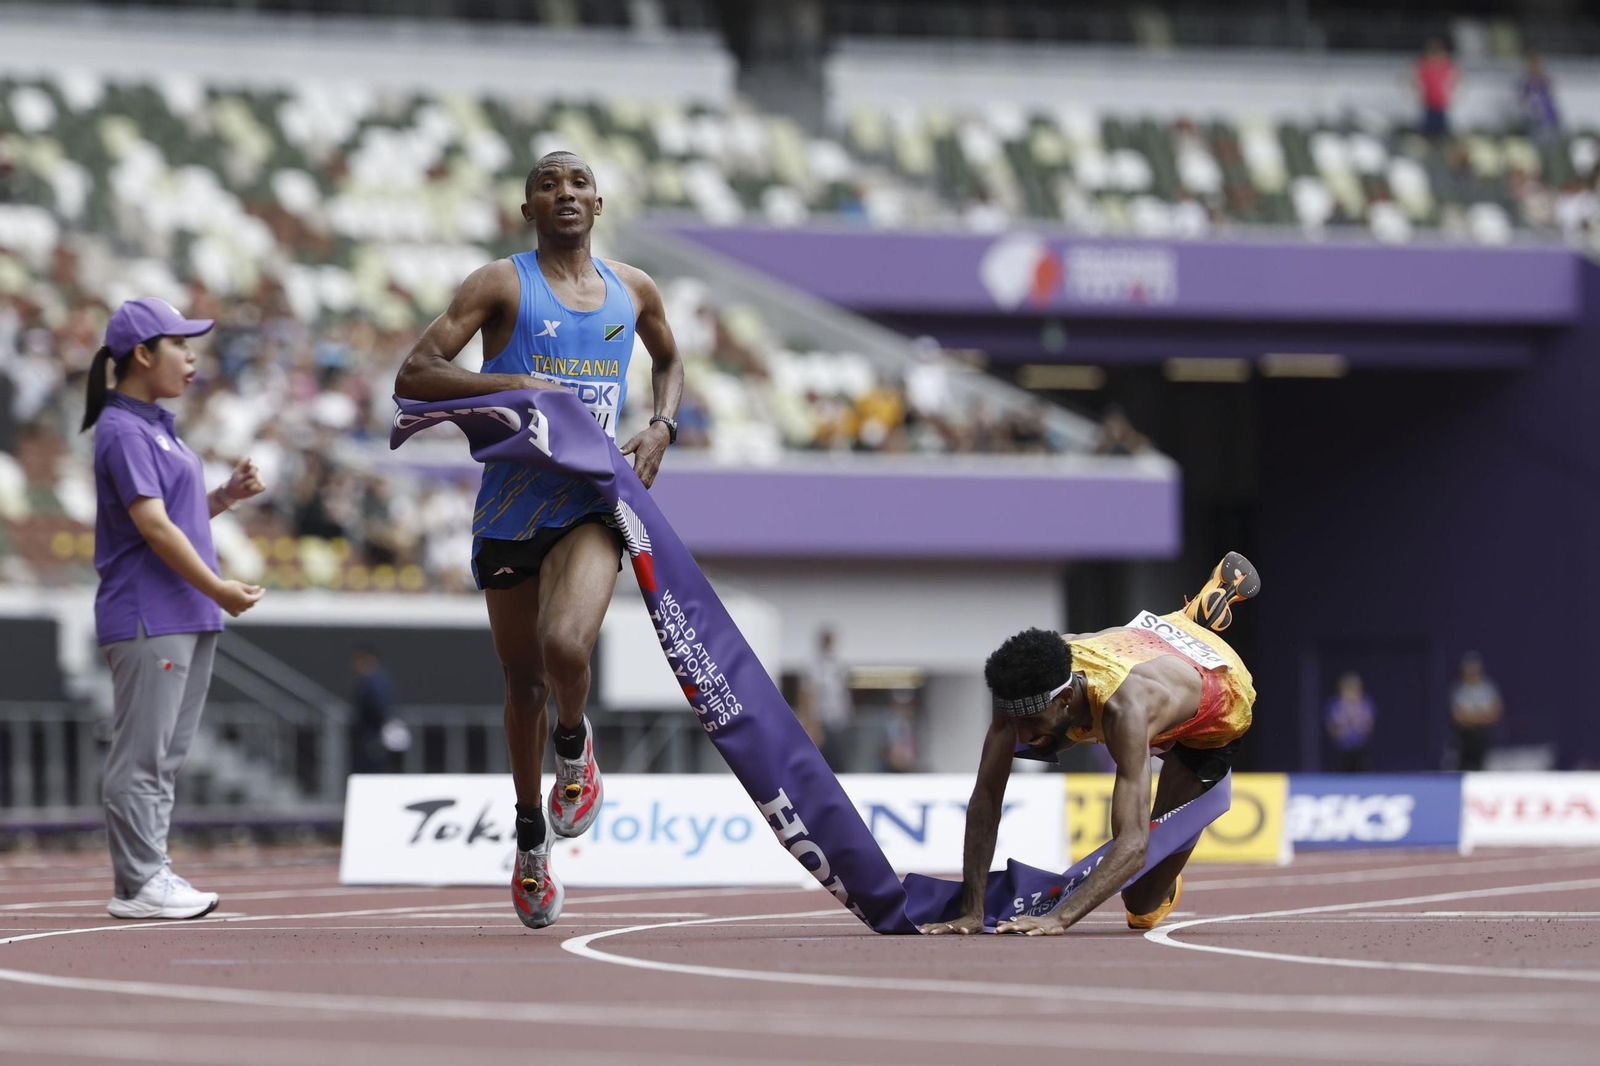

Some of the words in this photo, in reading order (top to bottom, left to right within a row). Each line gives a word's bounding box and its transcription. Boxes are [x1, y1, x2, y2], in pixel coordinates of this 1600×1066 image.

[531, 354, 619, 377] TANZANIA
[559, 381, 615, 406] DK
[659, 601, 730, 726] CHAMPIONSHIPS
[662, 589, 696, 641] WORLD
[692, 642, 743, 716] ATHLETICS
[590, 800, 756, 858] Tokyo
[1464, 795, 1599, 823] NDA
